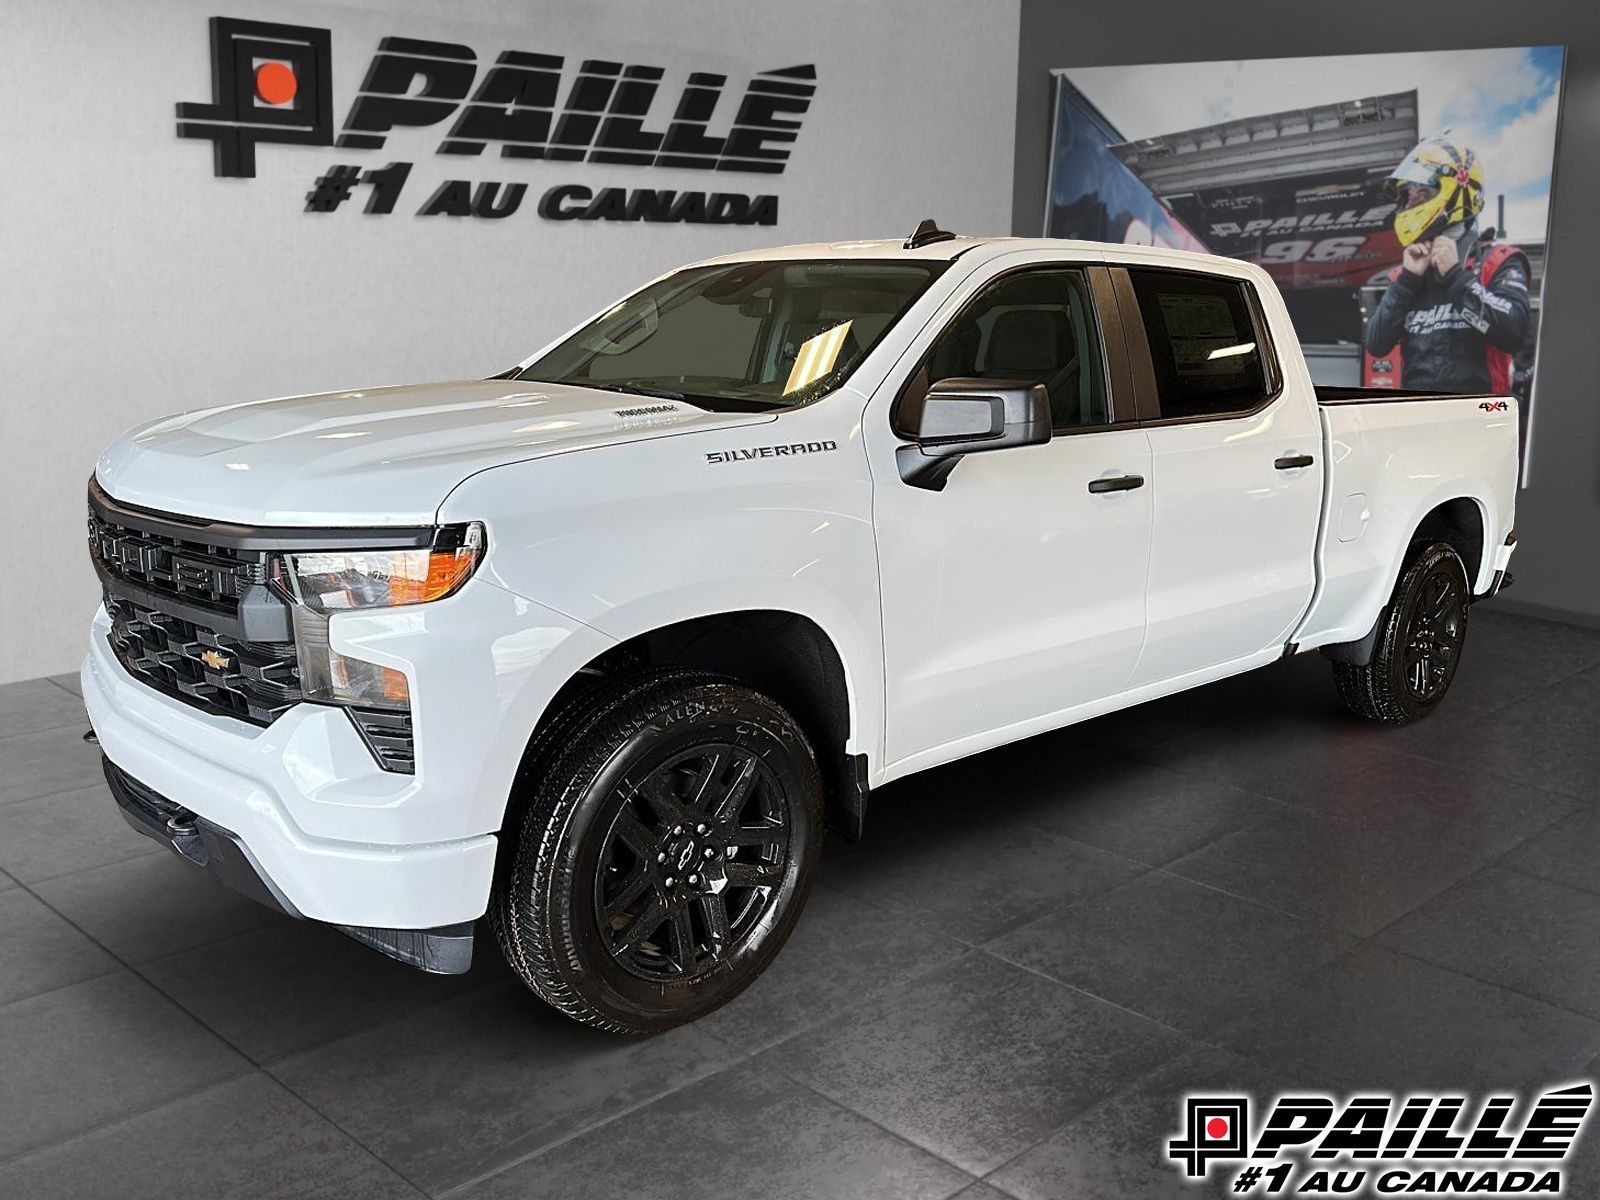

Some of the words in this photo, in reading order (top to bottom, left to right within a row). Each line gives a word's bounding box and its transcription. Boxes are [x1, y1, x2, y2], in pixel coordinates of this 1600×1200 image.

[334, 36, 816, 174] PAILLÉ
[304, 162, 414, 215] #1
[415, 180, 527, 218] AU
[537, 184, 779, 225] CANADA
[1299, 220, 1384, 233] CANADA
[1261, 236, 1367, 264] 96
[705, 440, 837, 464] SILVERADO
